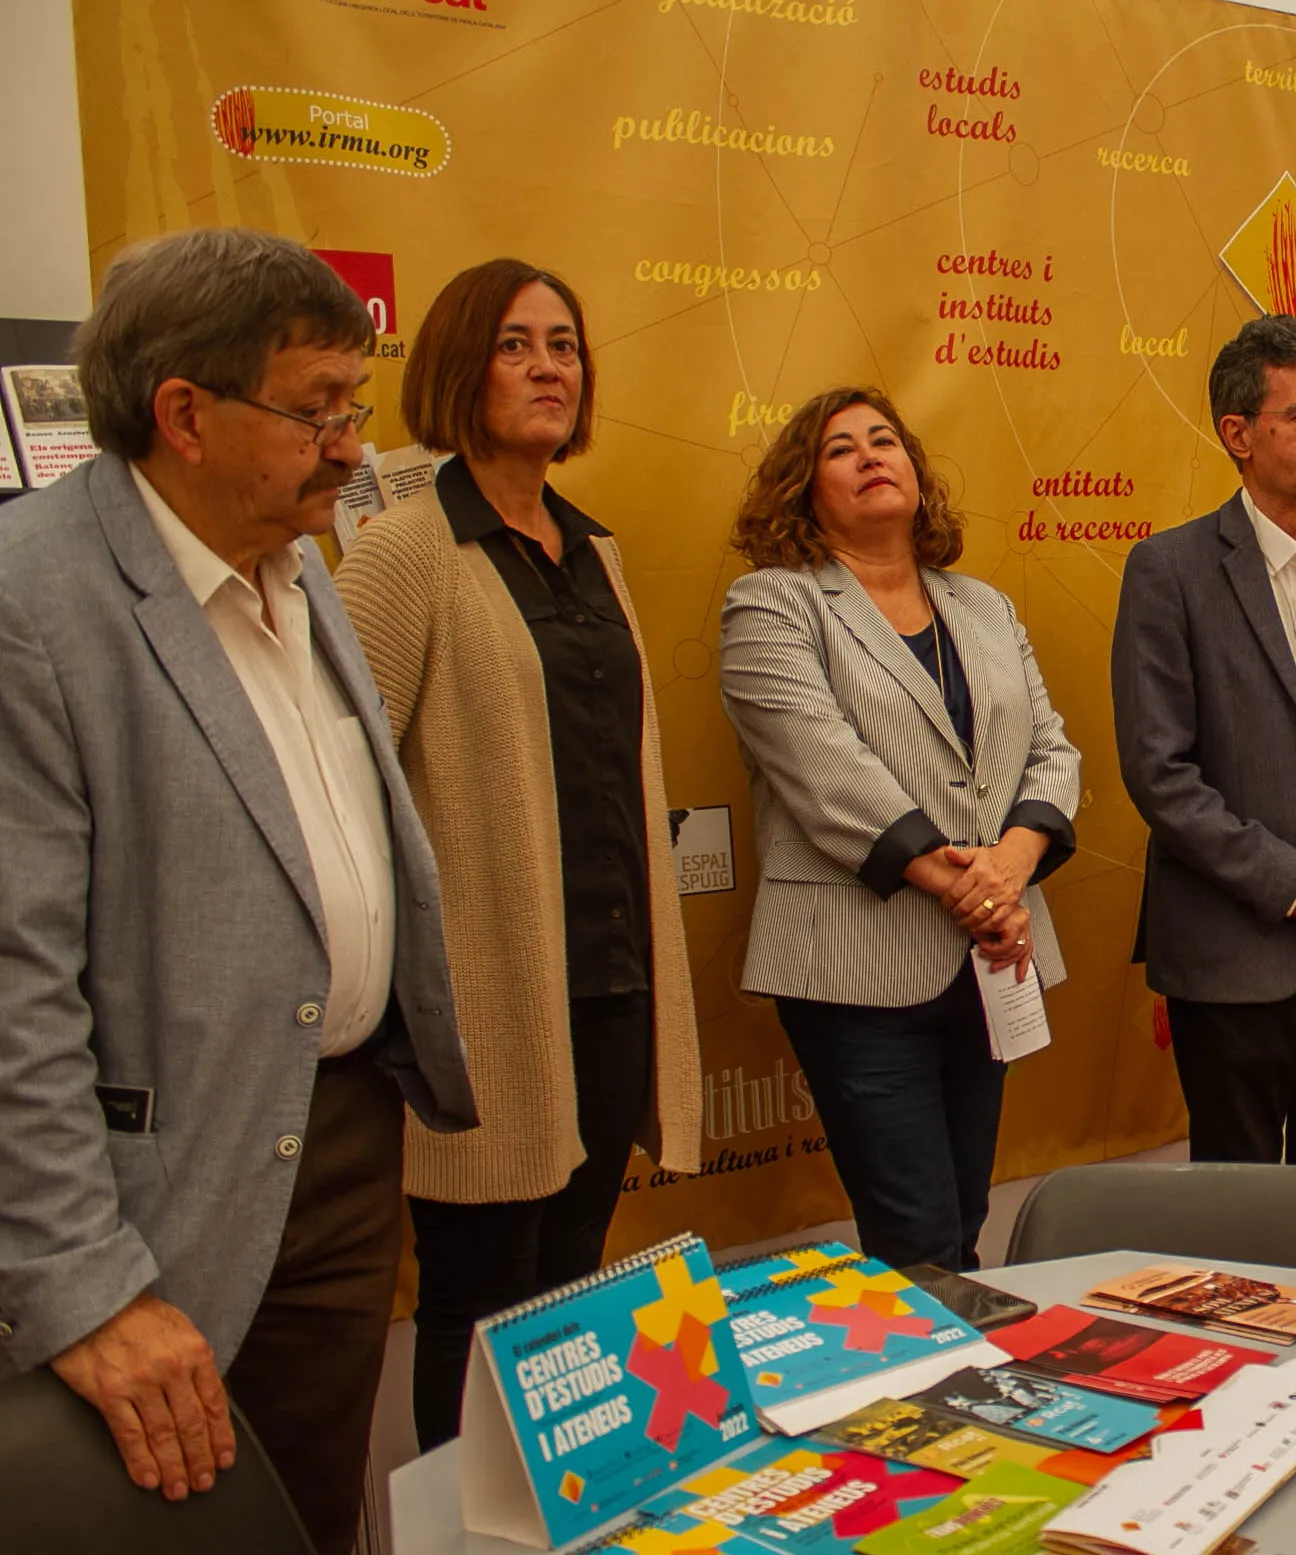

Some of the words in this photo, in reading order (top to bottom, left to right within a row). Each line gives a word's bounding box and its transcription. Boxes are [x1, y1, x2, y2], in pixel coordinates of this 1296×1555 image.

[918, 66, 1021, 100] estudis
[309, 105, 369, 130] Portal
[612, 107, 834, 158] publicacions
[927, 103, 1017, 143] locals
[240, 124, 430, 169] www.irmu.org
[1097, 146, 1191, 176] recerca
[634, 258, 823, 297] congressos
[936, 251, 1033, 281] centres
[1043, 255, 1054, 282] i
[938, 292, 1054, 327] instituts
[934, 333, 1061, 371] d'estudis
[1119, 324, 1188, 357] local
[728, 391, 792, 436] fire
[1032, 470, 1135, 498] entitats
[1018, 510, 1047, 542] de
[1056, 515, 1153, 542] recerca
[682, 852, 728, 872] ESPAI
[680, 870, 730, 891] SPUIG
[703, 1057, 815, 1140] tituts
[785, 1135, 793, 1157] i
[516, 1331, 601, 1390] CENTRES
[739, 1332, 824, 1367] ATENEUS
[524, 1353, 623, 1421] D'ESTUDIS
[538, 1432, 553, 1462] I
[553, 1395, 633, 1456] ATENEUS
[719, 1412, 749, 1442] 2022
[688, 1467, 791, 1517] CENTRES
[776, 1479, 878, 1533] ATENEUS
